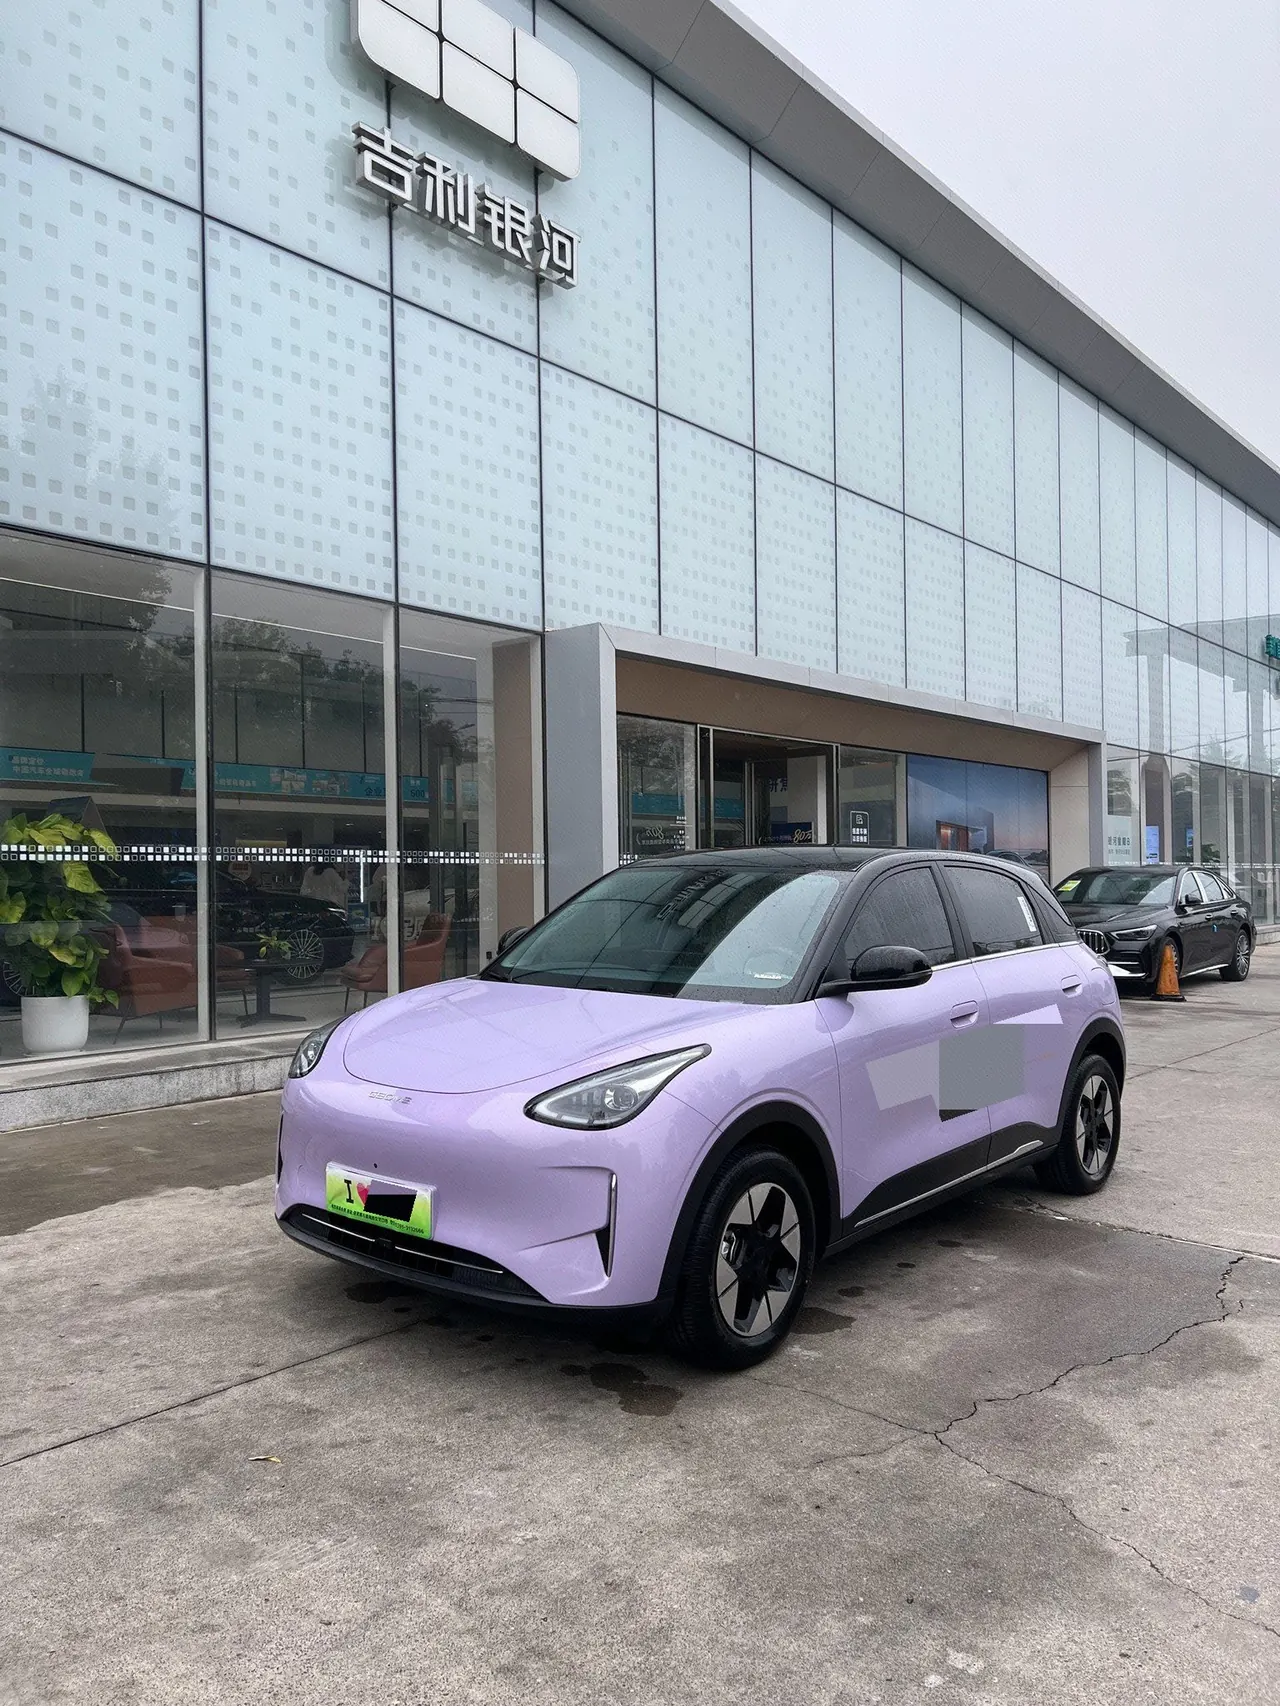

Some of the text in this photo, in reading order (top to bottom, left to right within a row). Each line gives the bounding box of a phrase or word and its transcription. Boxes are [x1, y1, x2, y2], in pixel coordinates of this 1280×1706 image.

[352, 121, 581, 289] 吉利银河
[344, 1179, 355, 1204] I
